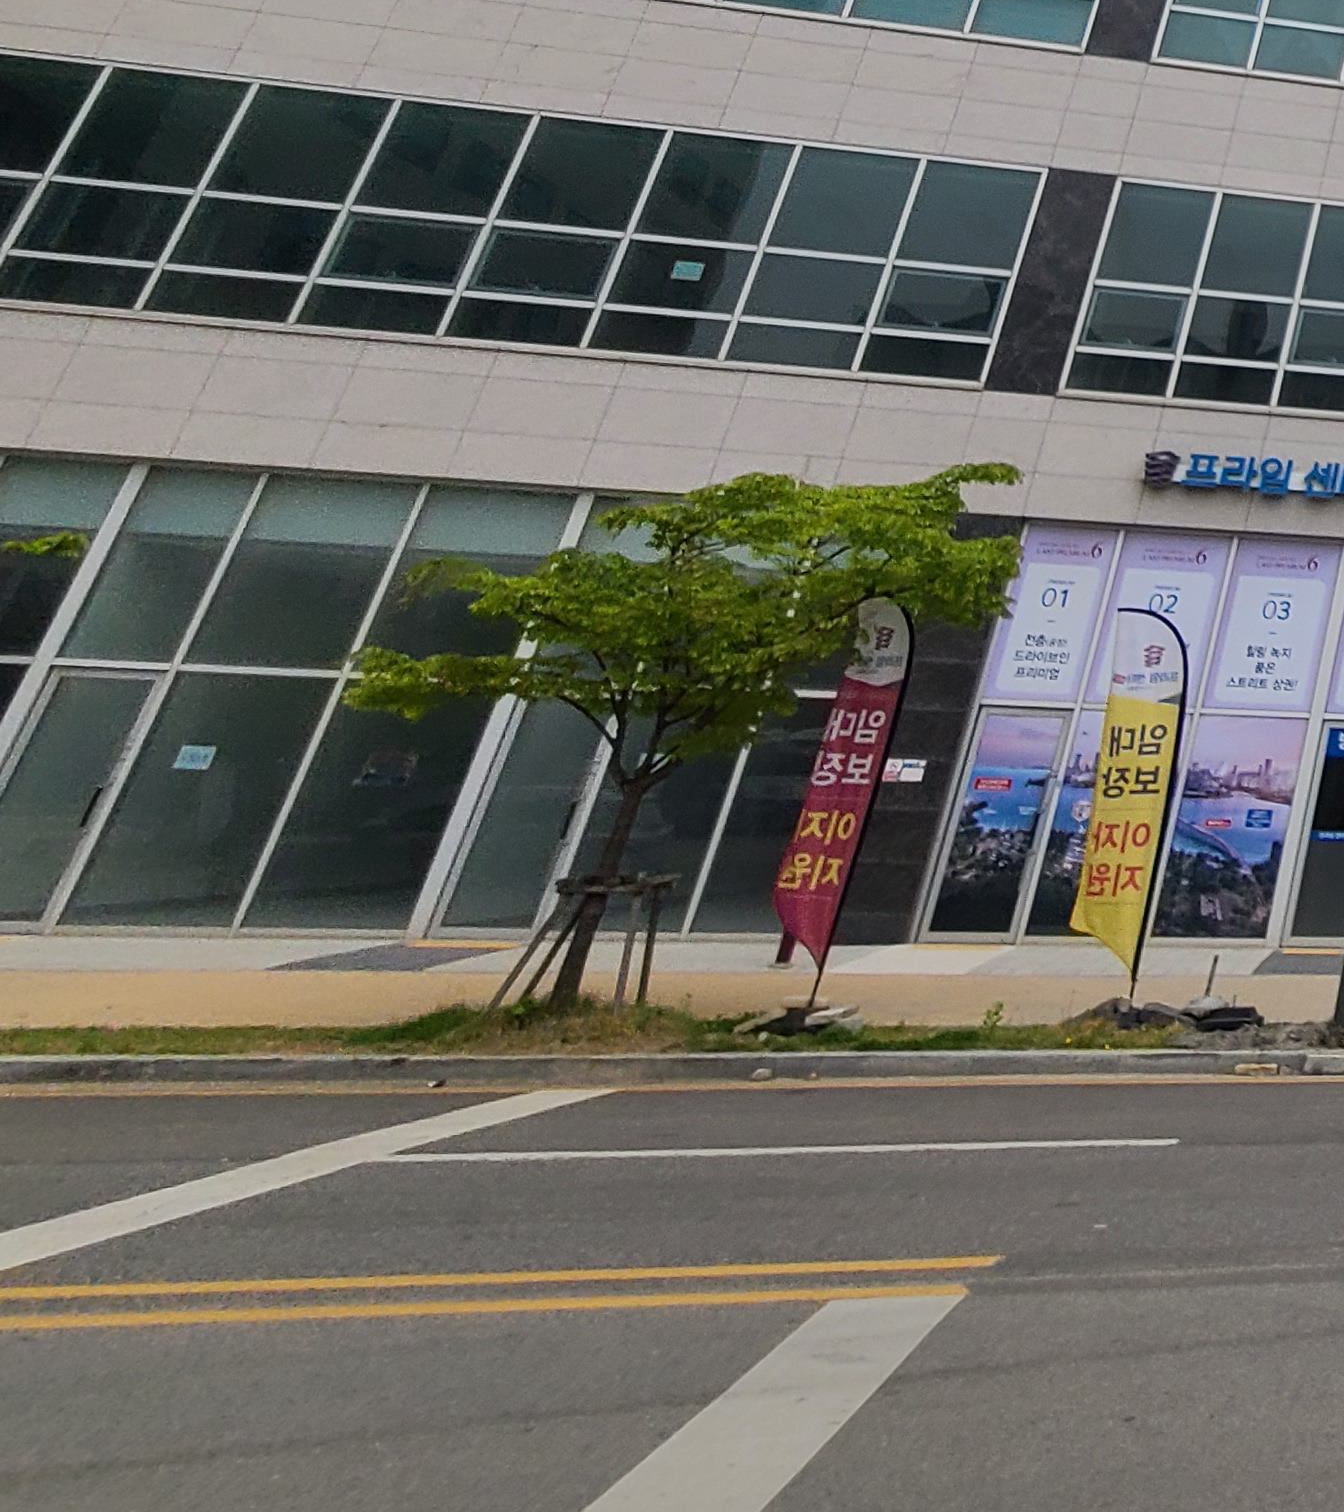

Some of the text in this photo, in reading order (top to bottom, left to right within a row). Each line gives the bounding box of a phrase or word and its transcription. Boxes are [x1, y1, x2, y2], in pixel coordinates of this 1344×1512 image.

[1180, 453, 1293, 495] 프라임
[1091, 542, 1103, 559] 6
[1196, 550, 1208, 566] 6
[1307, 555, 1319, 573] 6
[1041, 587, 1069, 608] 01
[1148, 593, 1179, 614] 02
[1262, 600, 1291, 621] 03
